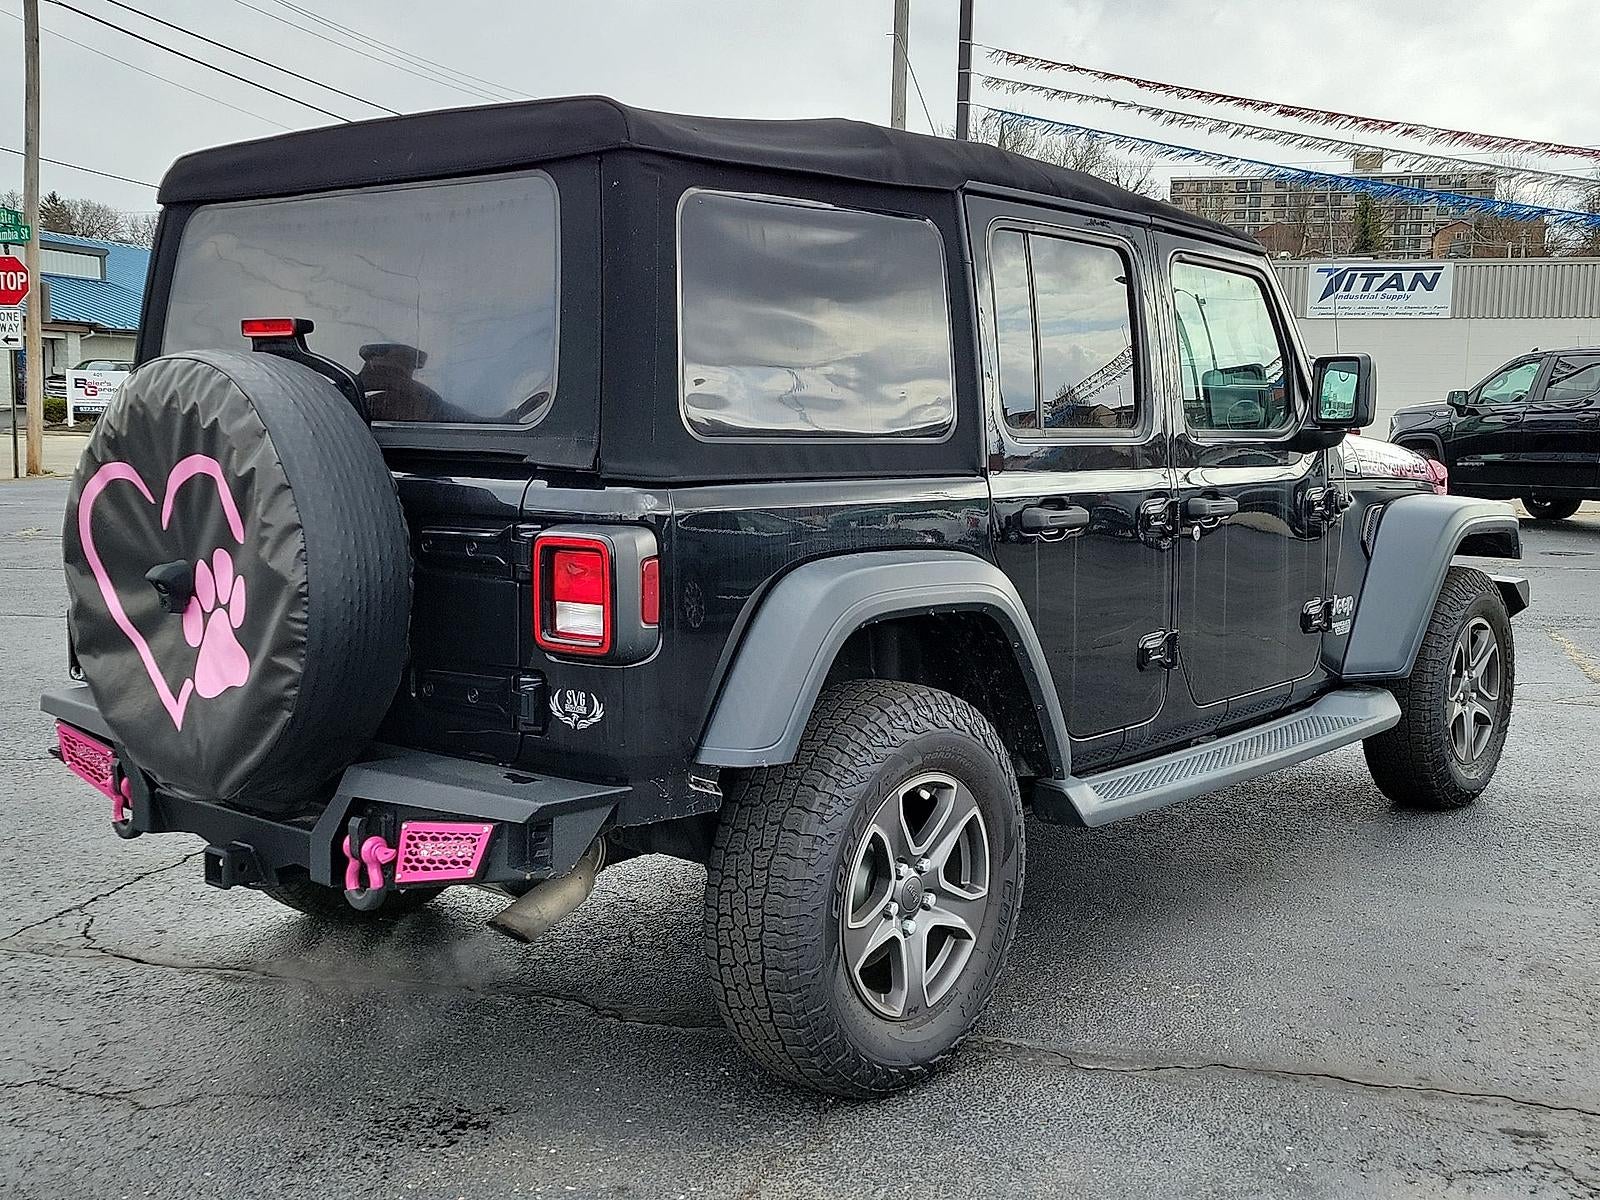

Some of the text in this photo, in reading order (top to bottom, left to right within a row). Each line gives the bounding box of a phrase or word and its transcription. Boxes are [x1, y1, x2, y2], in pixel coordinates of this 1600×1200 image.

[20, 227, 30, 240] St
[1316, 265, 1445, 303] TITAN
[1335, 292, 1411, 301] Industrial Supply
[1332, 594, 1354, 616] Jeep
[566, 689, 586, 707] SVG
